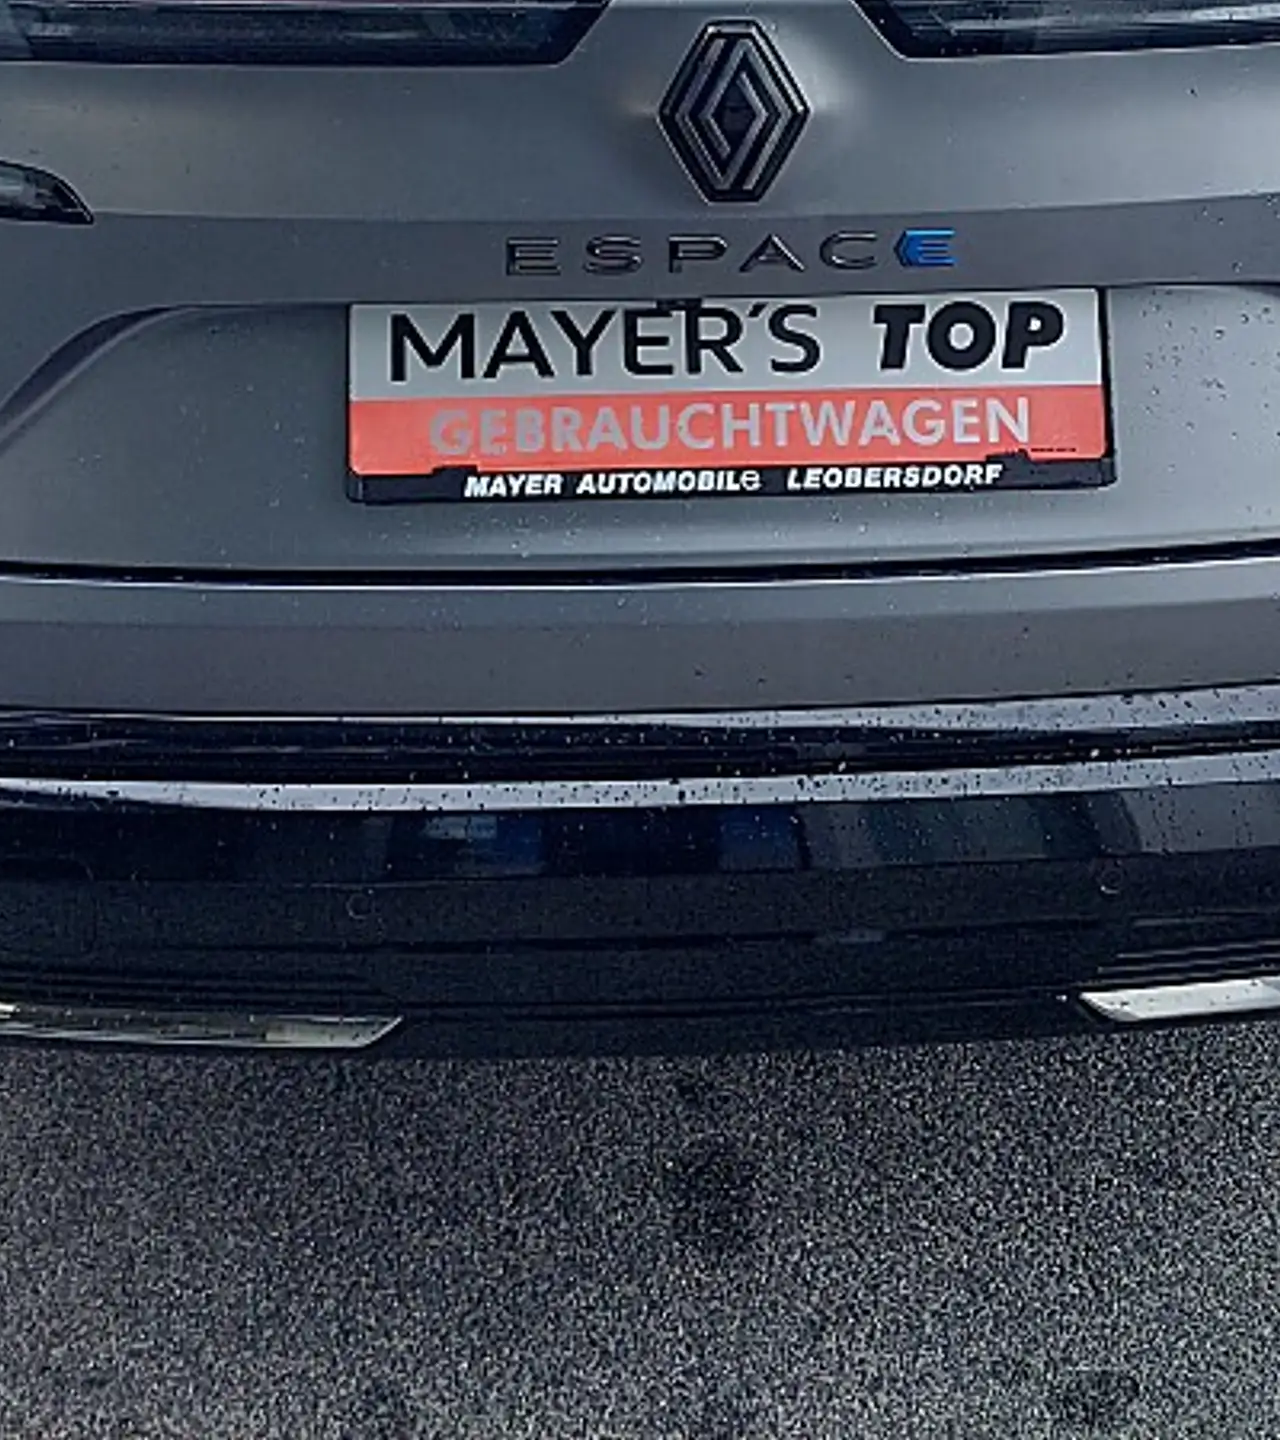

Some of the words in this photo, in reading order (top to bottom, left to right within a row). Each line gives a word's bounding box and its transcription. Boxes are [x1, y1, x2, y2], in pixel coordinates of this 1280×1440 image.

[505, 228, 958, 278] ESPACE
[389, 301, 822, 383] MAYER'S
[873, 300, 1065, 372] TOP
[429, 397, 1030, 456] GEBRAUCHTWAGEN
[464, 474, 564, 498] MAYER
[786, 463, 1003, 491] LEOBERSDORF
